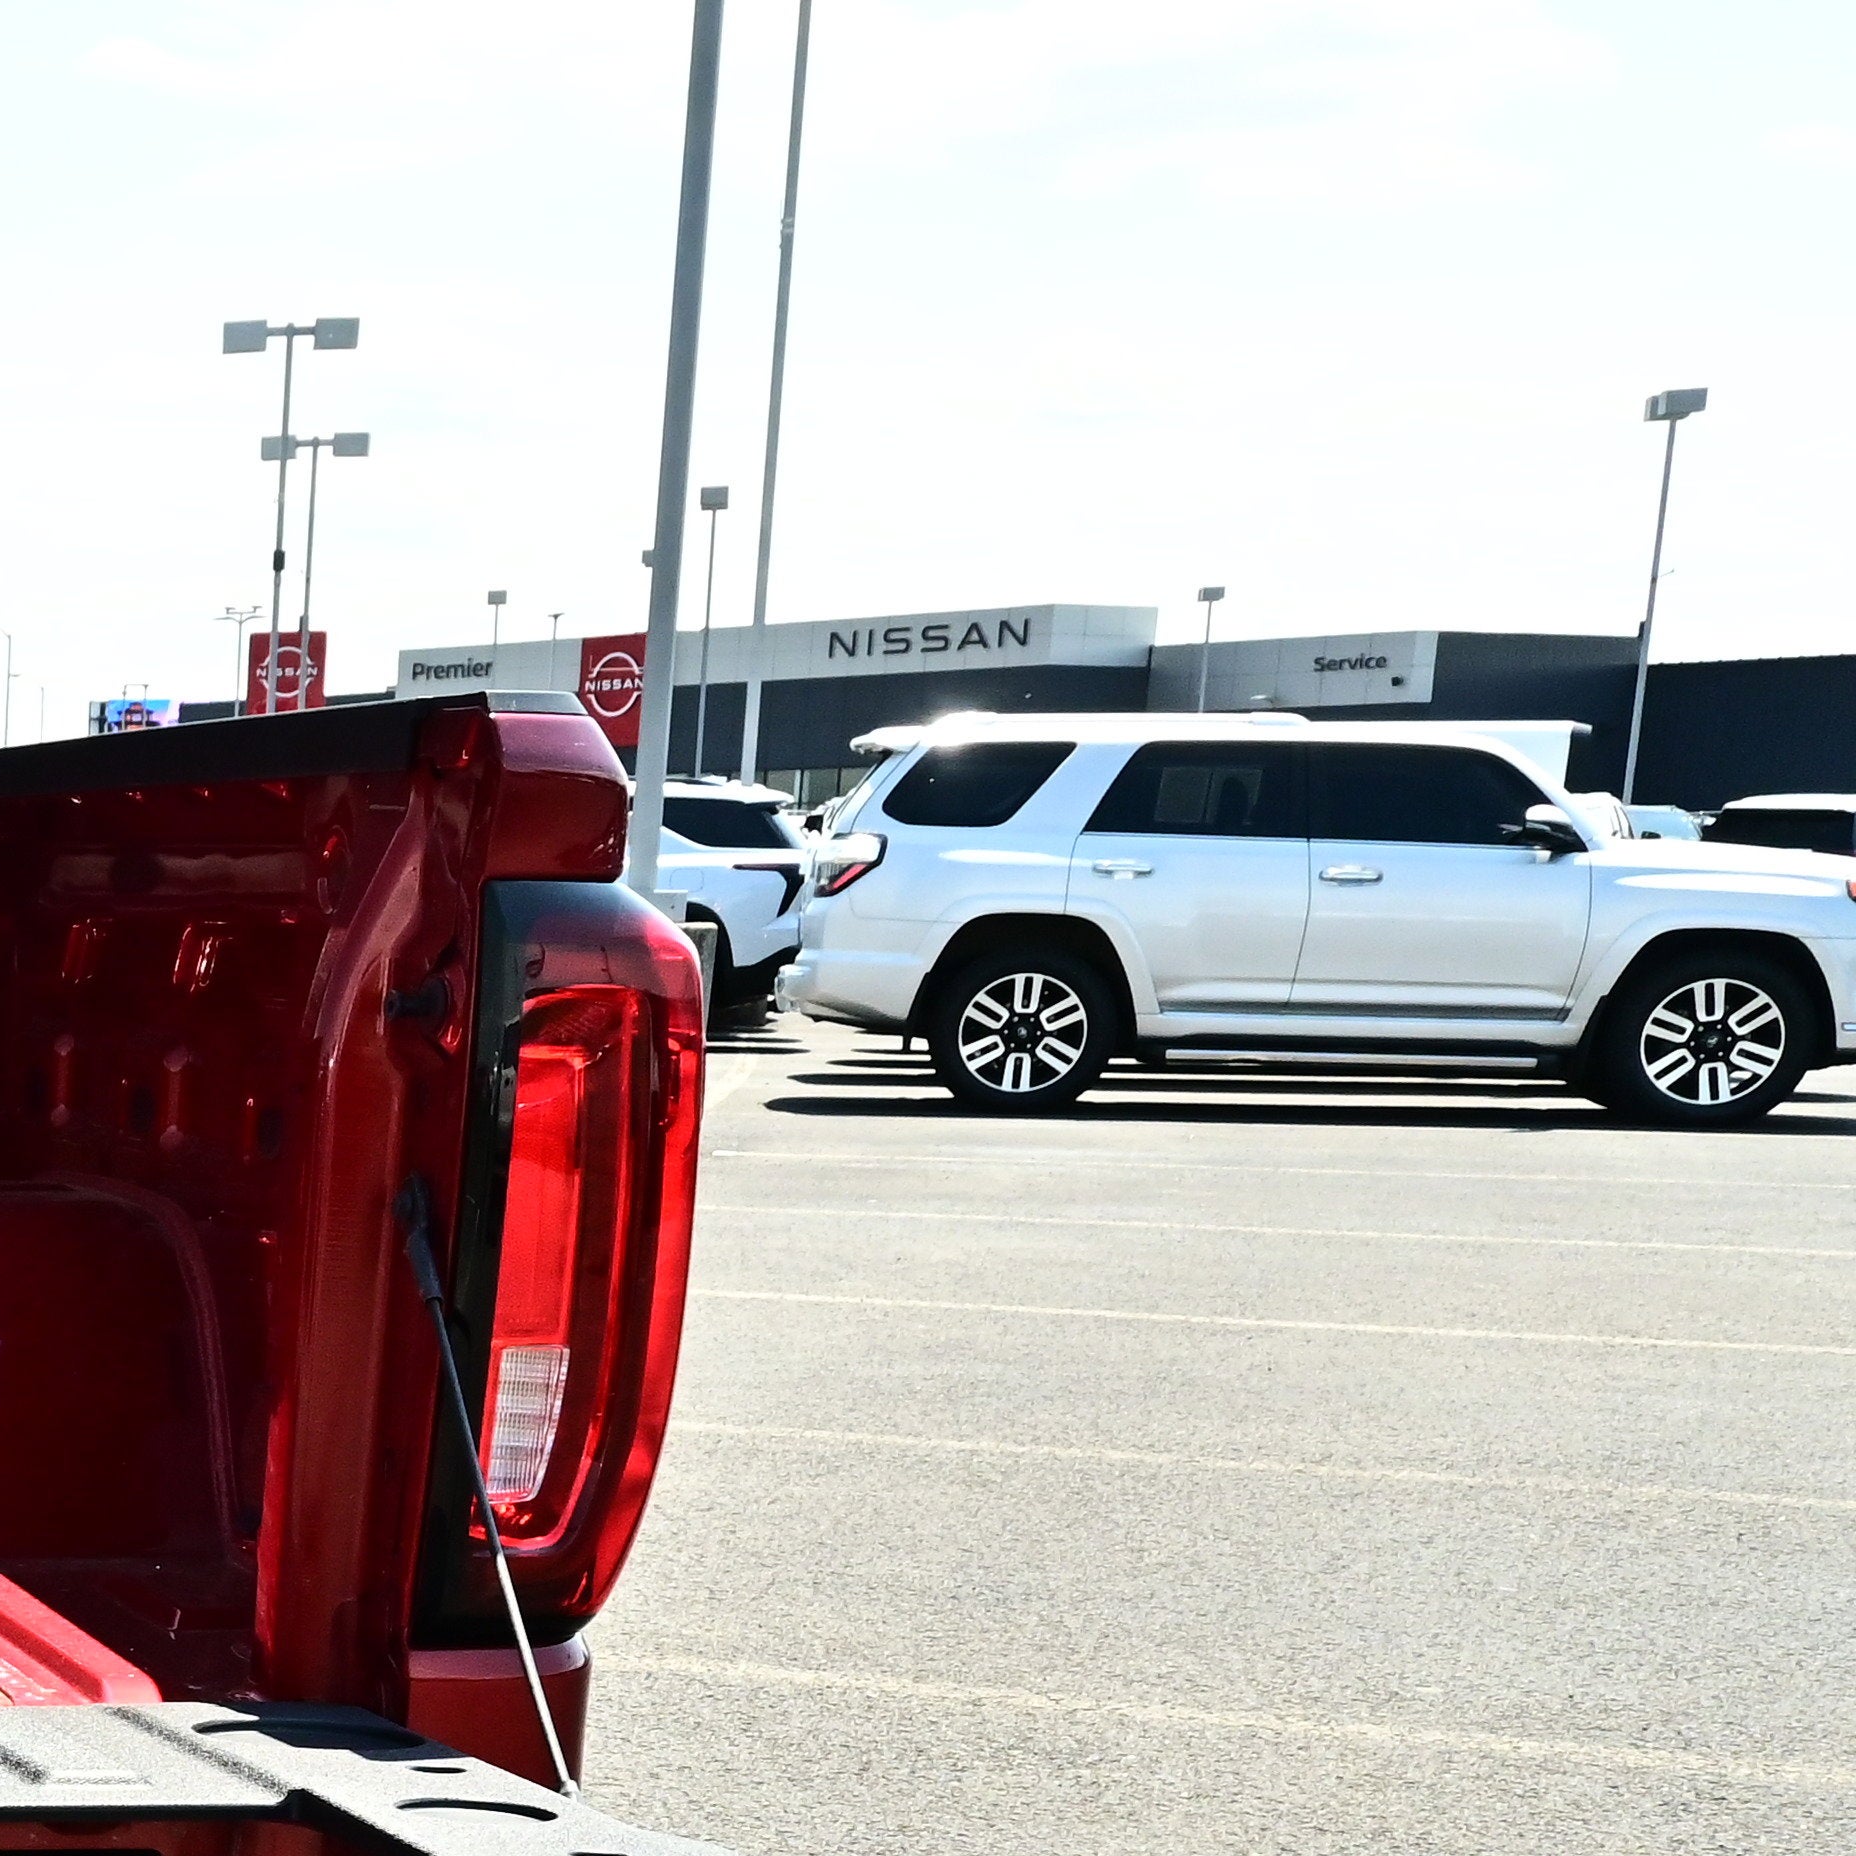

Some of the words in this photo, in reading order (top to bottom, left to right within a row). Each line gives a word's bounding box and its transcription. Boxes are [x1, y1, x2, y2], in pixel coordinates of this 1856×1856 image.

[828, 618, 1032, 659] NISSAN
[412, 658, 494, 680] Premier
[1313, 653, 1388, 672] Service
[585, 678, 644, 692] NISSAN
